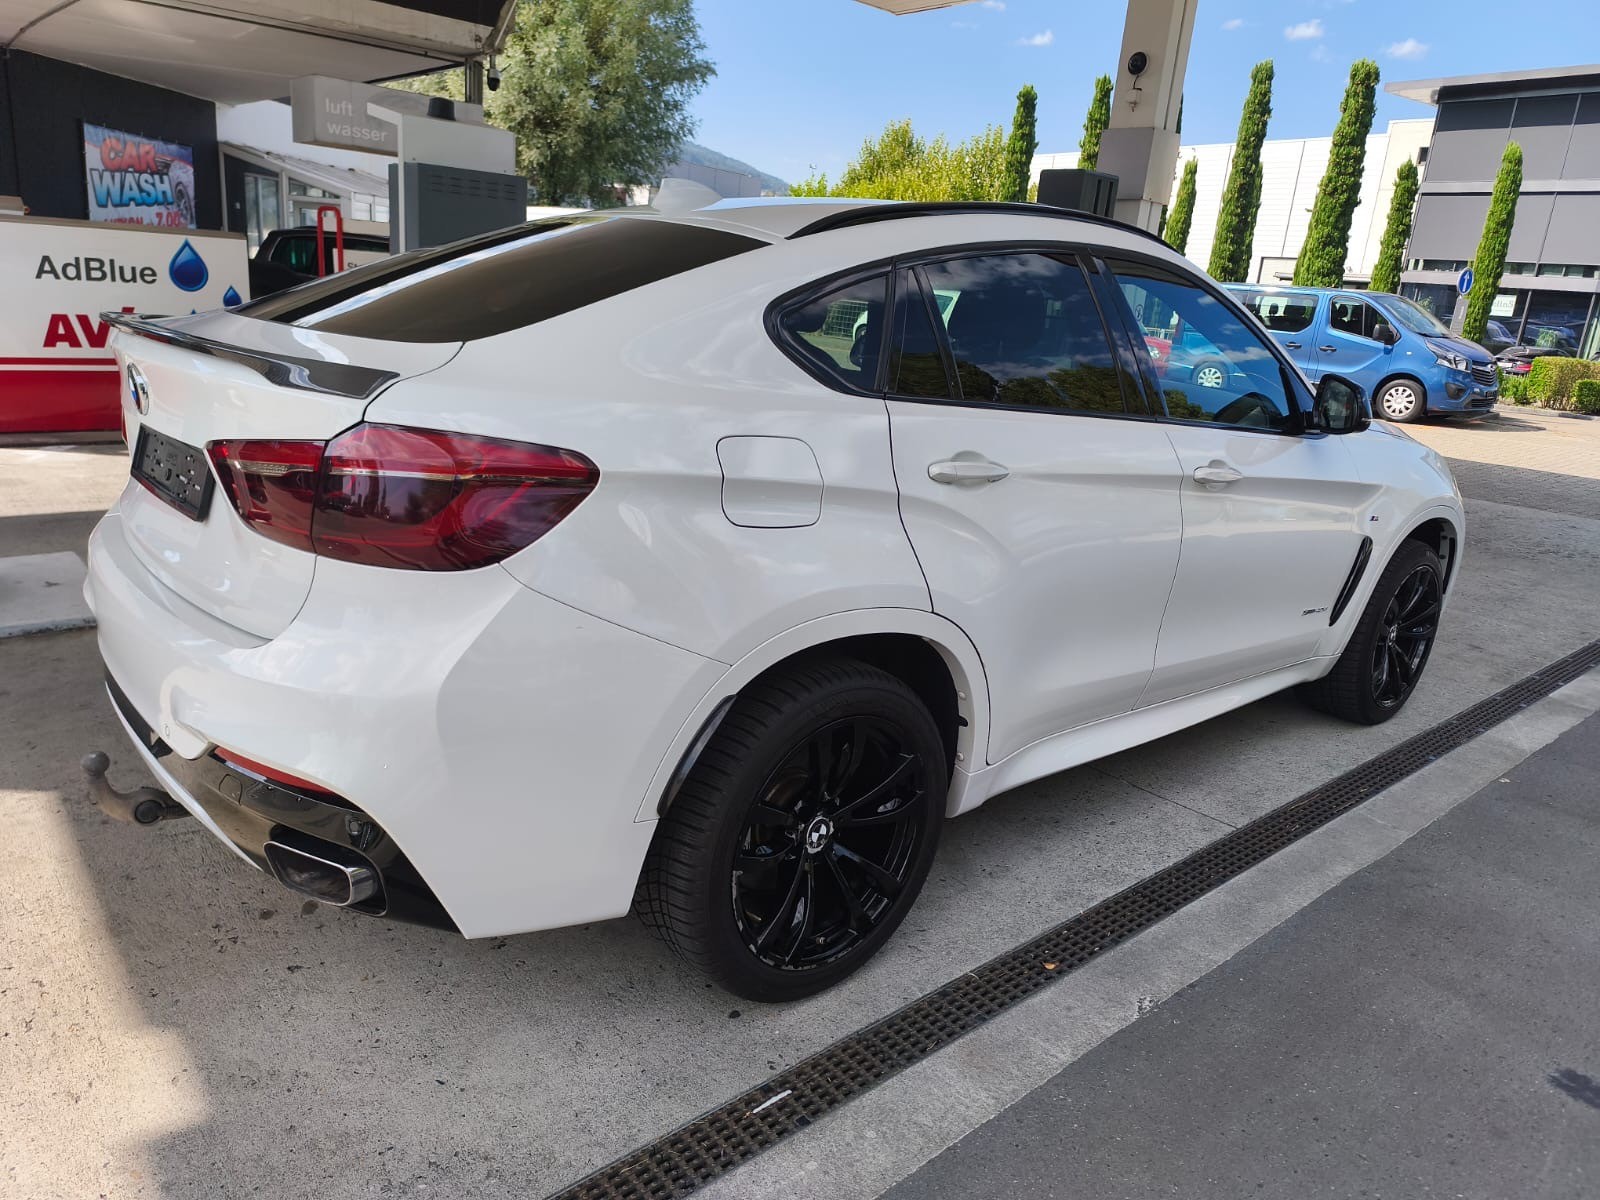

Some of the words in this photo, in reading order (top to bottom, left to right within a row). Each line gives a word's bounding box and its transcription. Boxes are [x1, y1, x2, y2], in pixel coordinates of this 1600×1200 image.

[325, 98, 353, 117] luft
[327, 122, 388, 142] wasser
[101, 137, 158, 172] CAR
[90, 168, 174, 208] WASH
[35, 255, 158, 284] AdBlue
